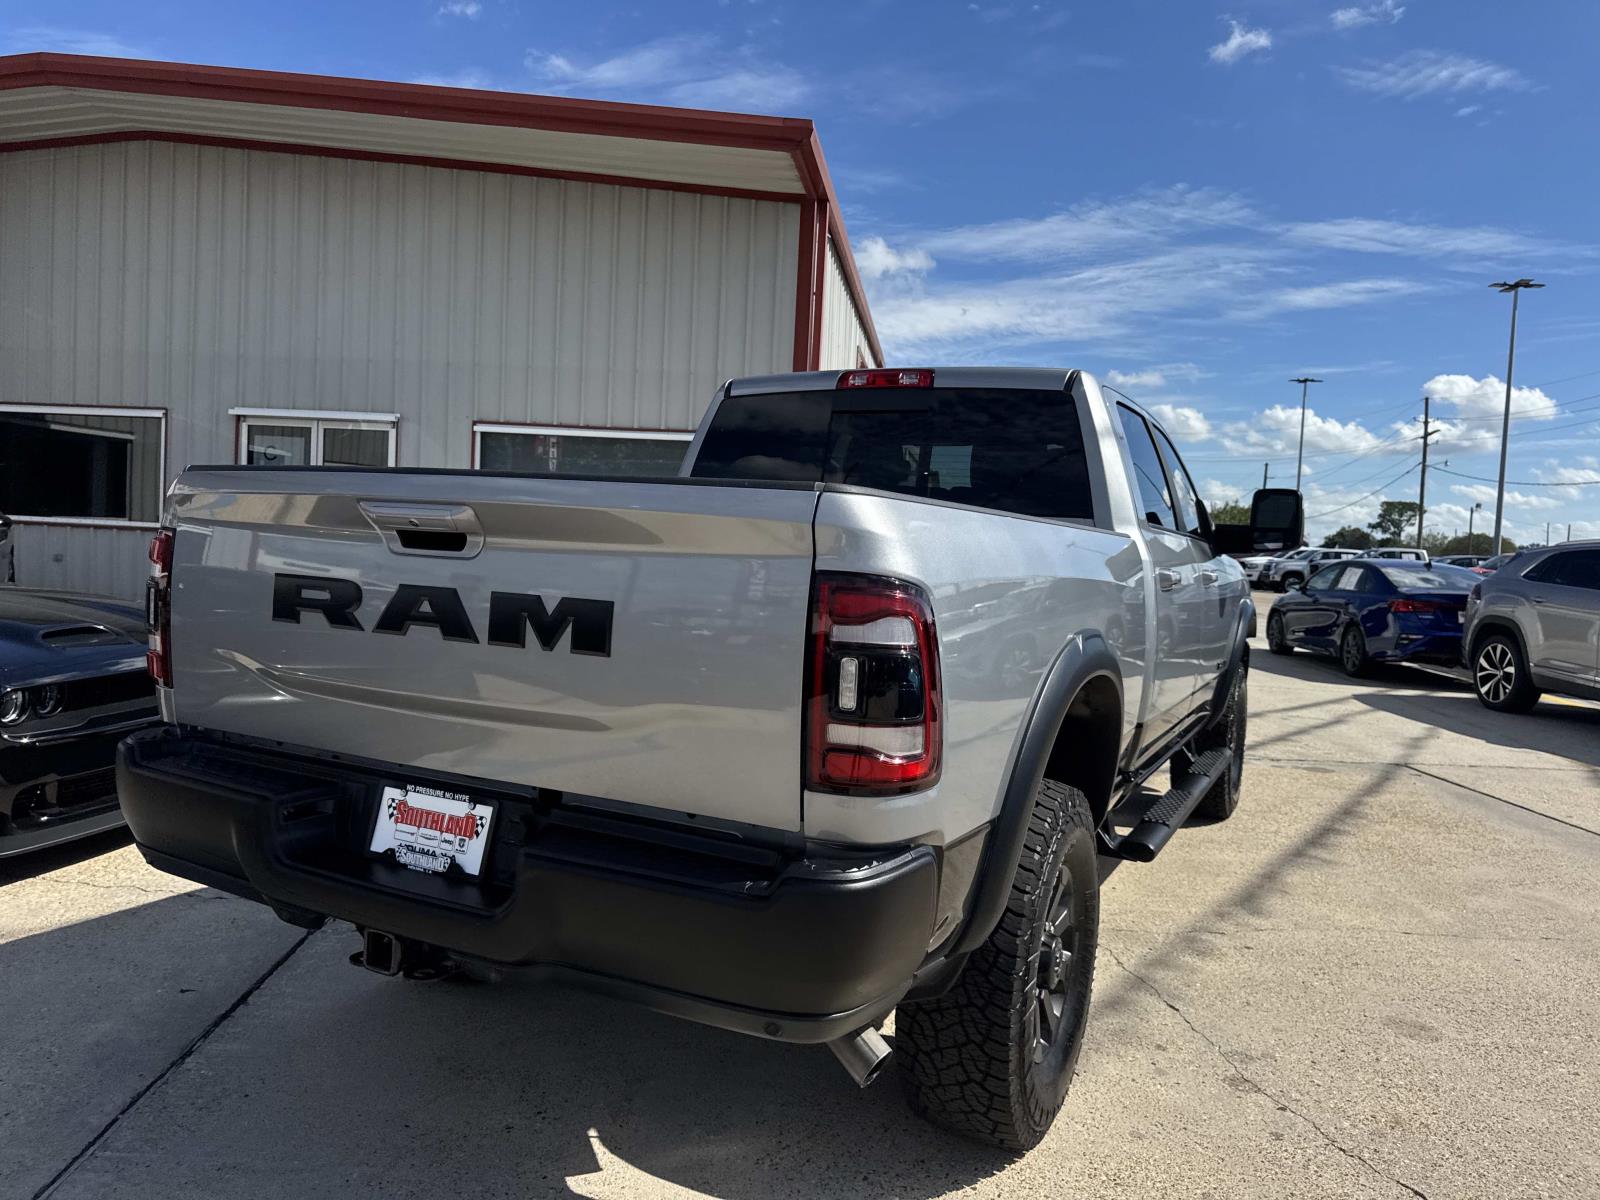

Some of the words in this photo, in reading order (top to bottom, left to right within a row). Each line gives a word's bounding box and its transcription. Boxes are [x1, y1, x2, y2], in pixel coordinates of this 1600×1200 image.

[272, 572, 615, 658] RAM
[406, 784, 415, 792] NO
[415, 785, 444, 798] PRESSURE
[445, 791, 454, 800] NO
[454, 793, 470, 803] HYPE
[396, 802, 476, 839] SOUTHLAND
